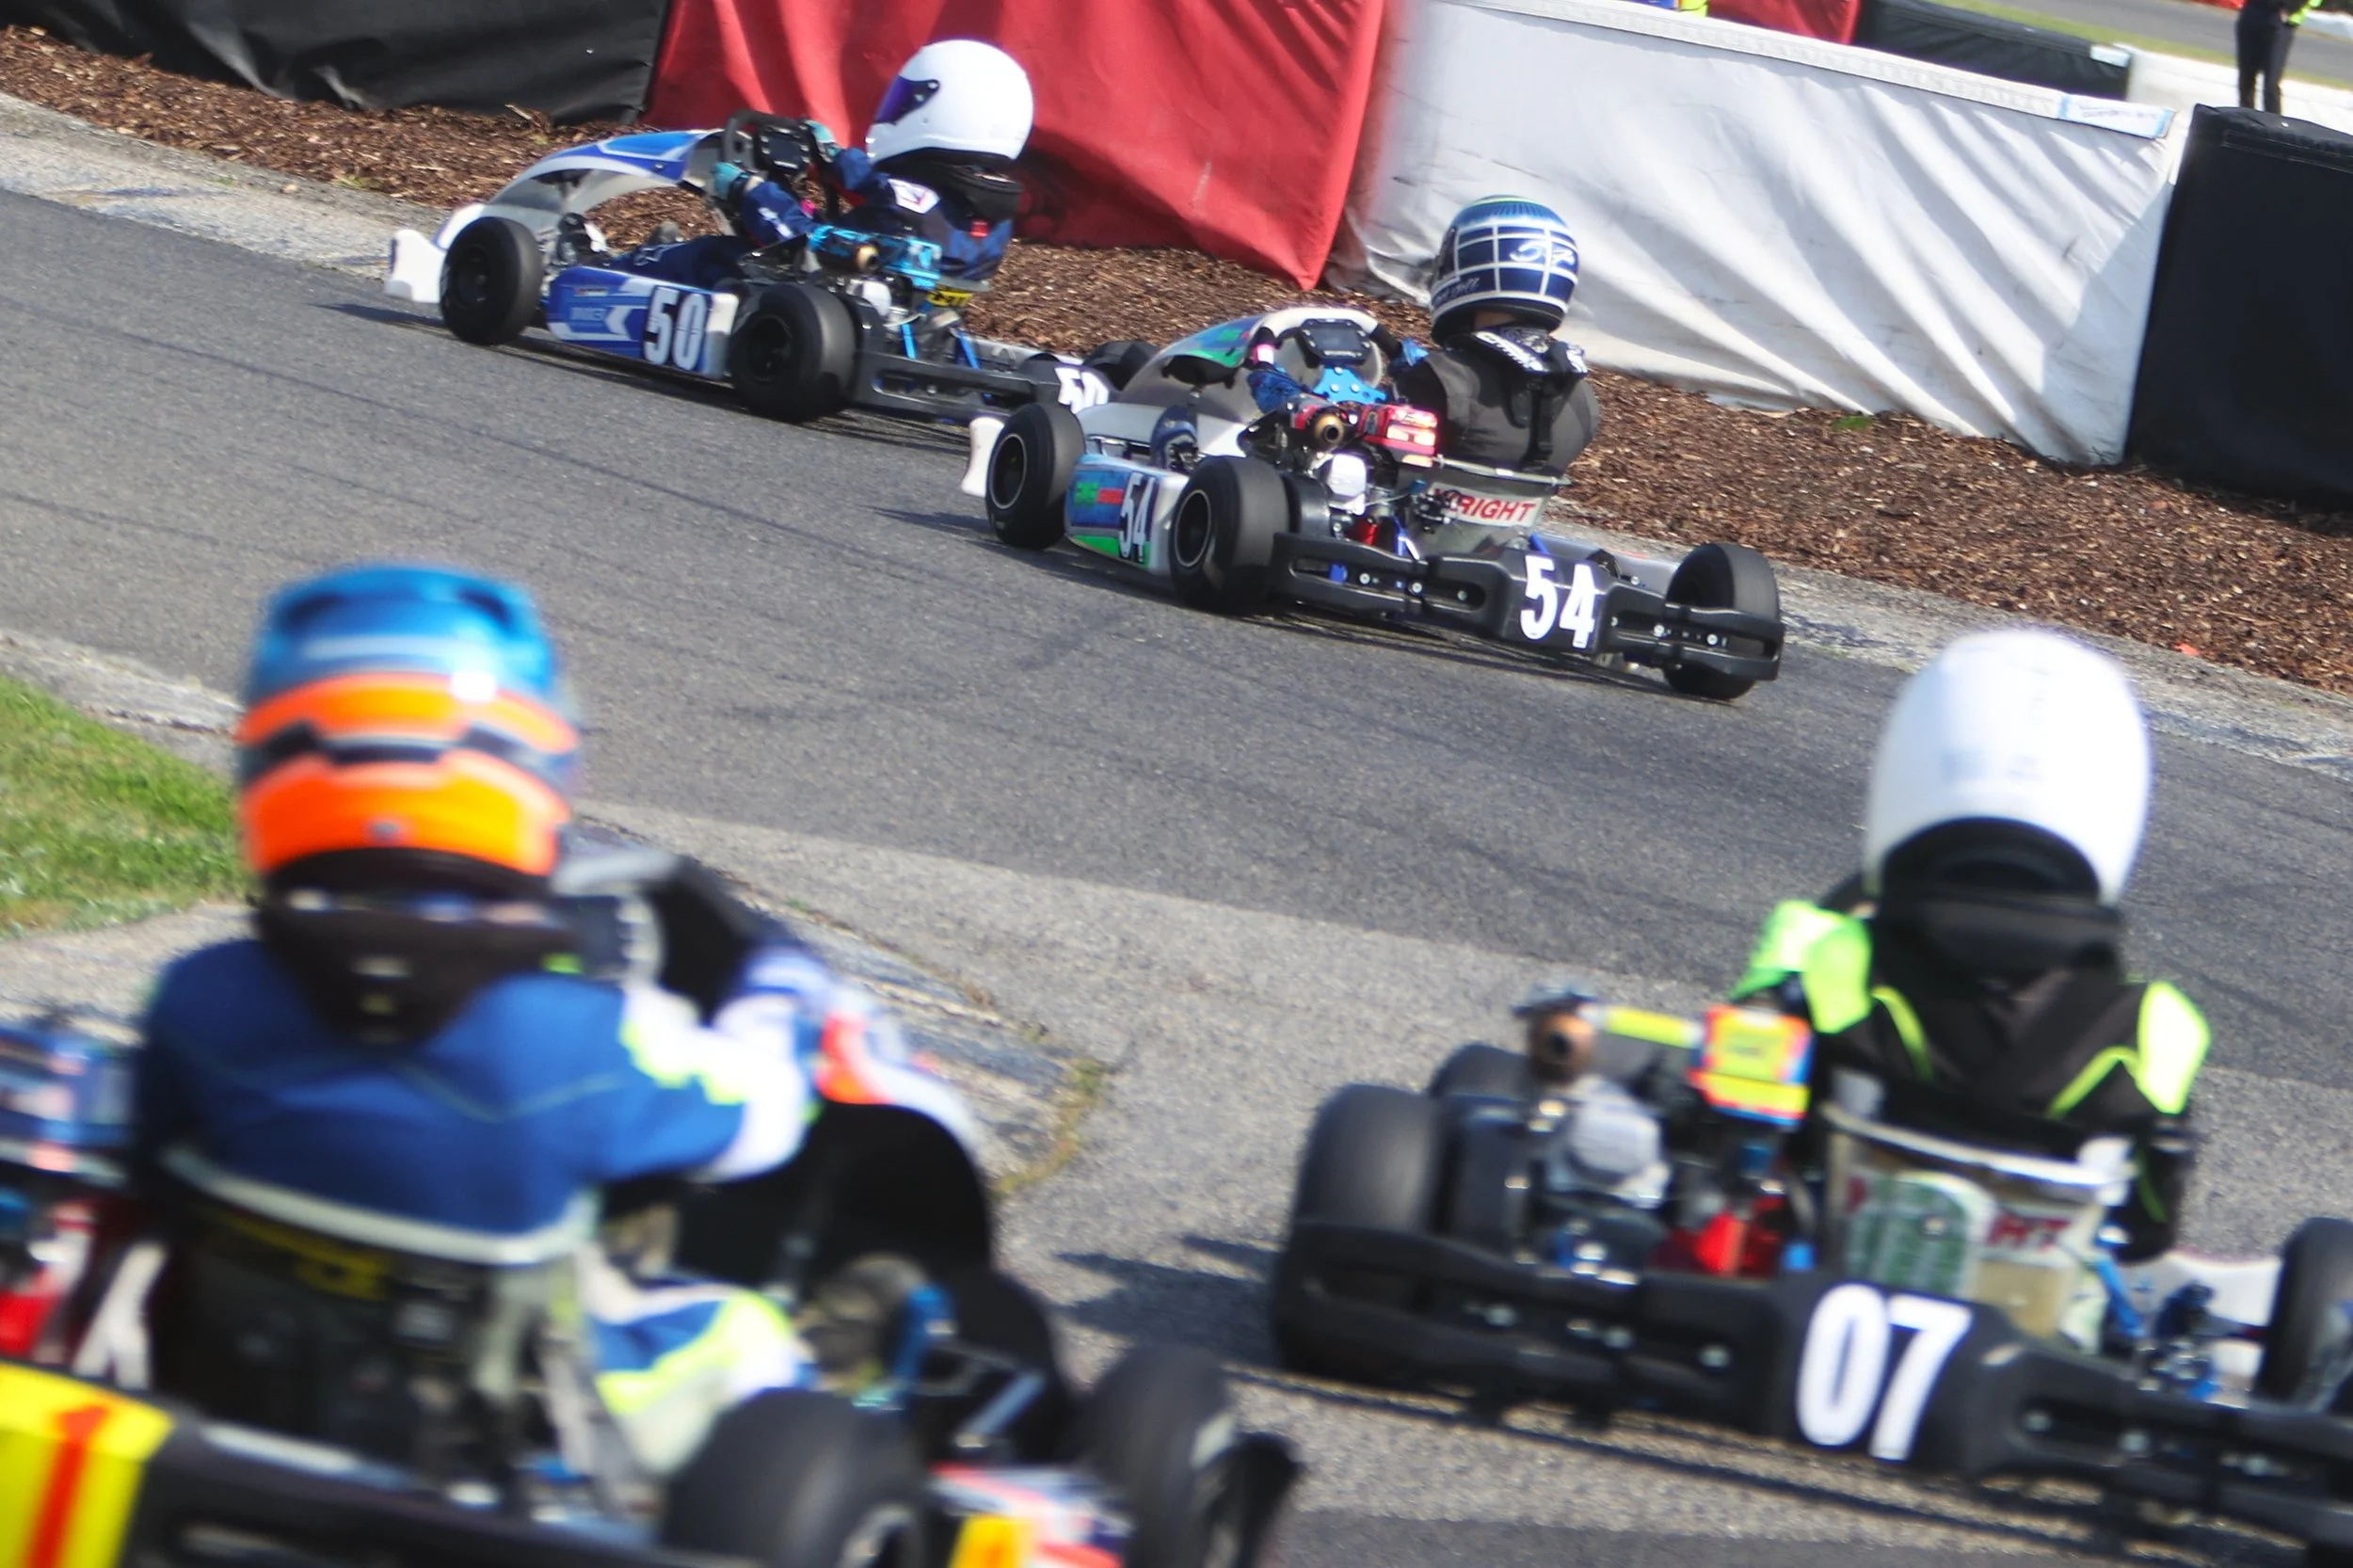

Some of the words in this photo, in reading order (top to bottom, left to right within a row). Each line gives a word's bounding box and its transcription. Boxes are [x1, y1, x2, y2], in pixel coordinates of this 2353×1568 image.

[643, 285, 707, 371] 50
[1118, 472, 1157, 563] 54
[1520, 554, 1596, 649] 54
[1796, 1282, 1973, 1461] 07
